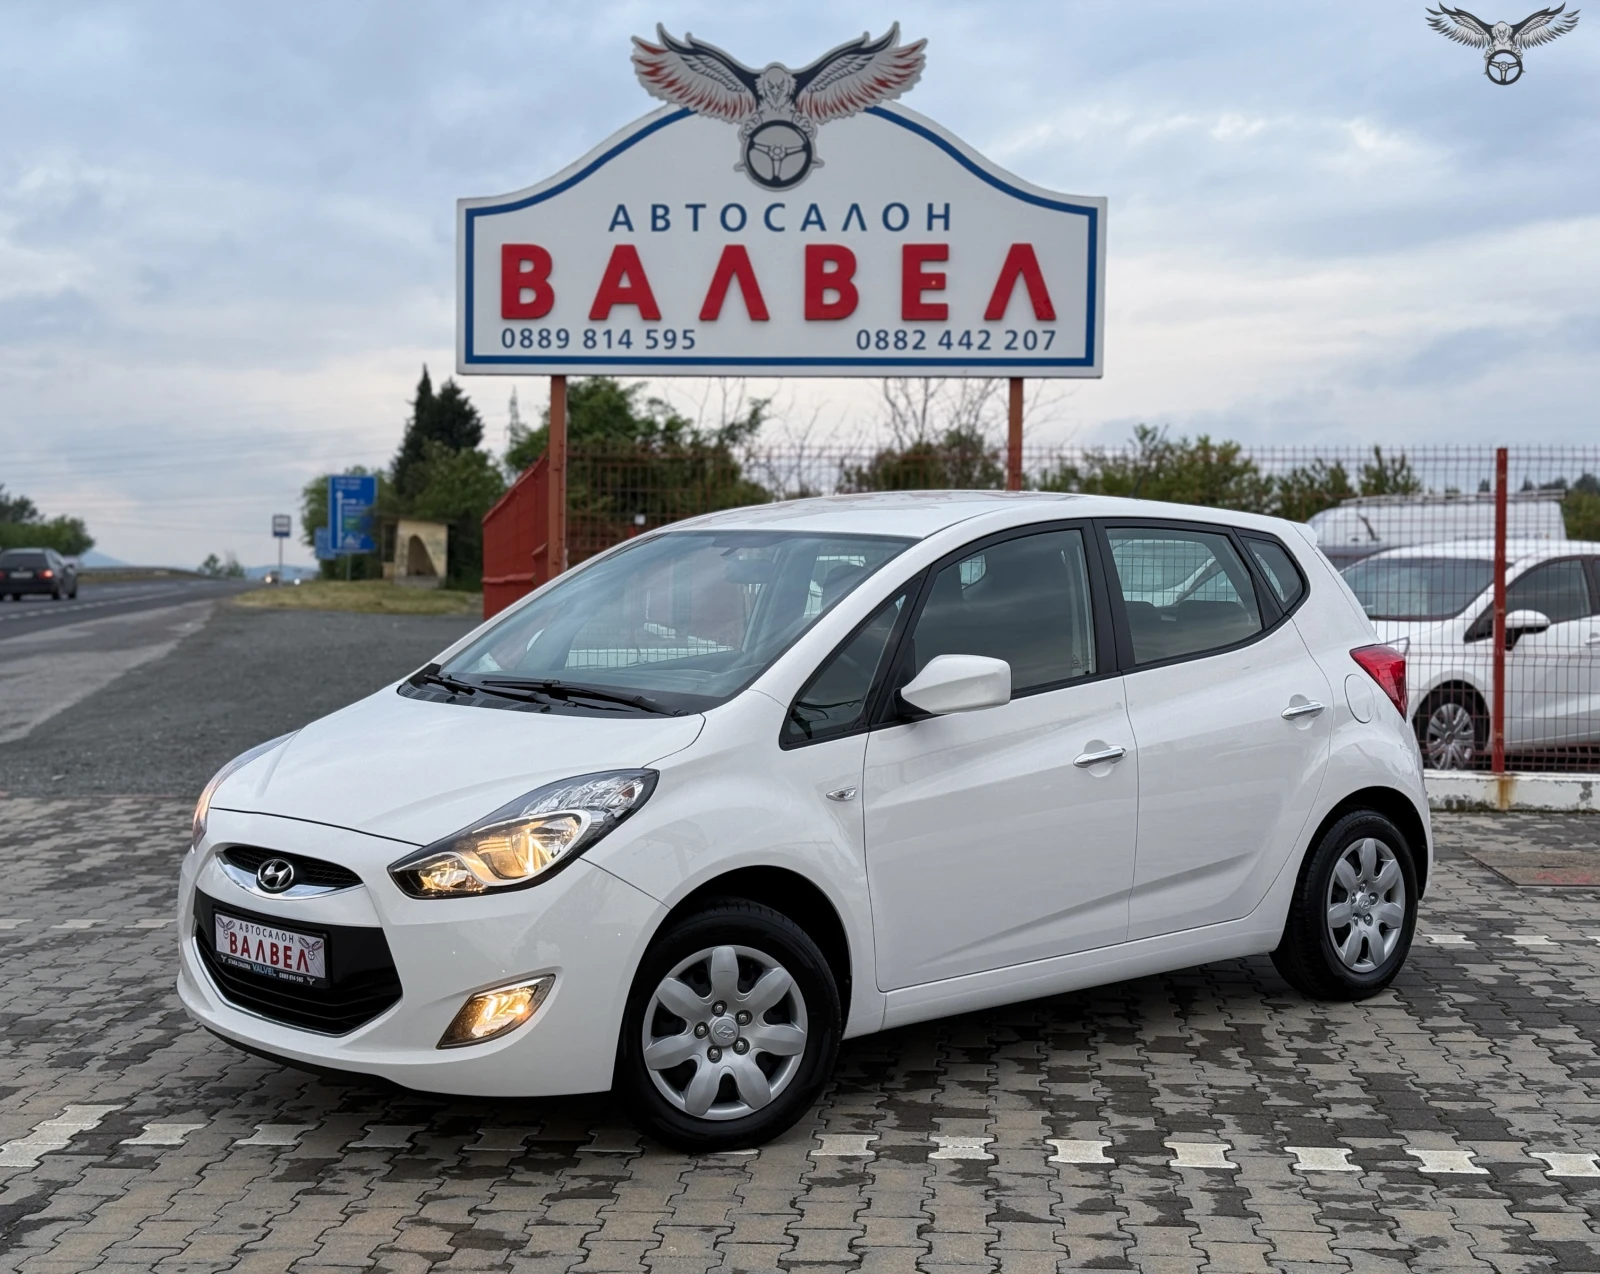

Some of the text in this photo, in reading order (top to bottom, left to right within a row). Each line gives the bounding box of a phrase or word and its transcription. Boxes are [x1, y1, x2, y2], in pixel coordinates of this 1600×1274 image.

[608, 202, 950, 232] АВТОСАЛОН
[501, 243, 1057, 323] ВАЛВЕЛ
[501, 328, 696, 351] 0889 814 595
[856, 329, 1057, 352] 0882 442 207
[239, 922, 294, 944] АВТОСАЛОН
[229, 931, 310, 973] ВАЛВЕЛ
[252, 963, 277, 977] VALVEL
